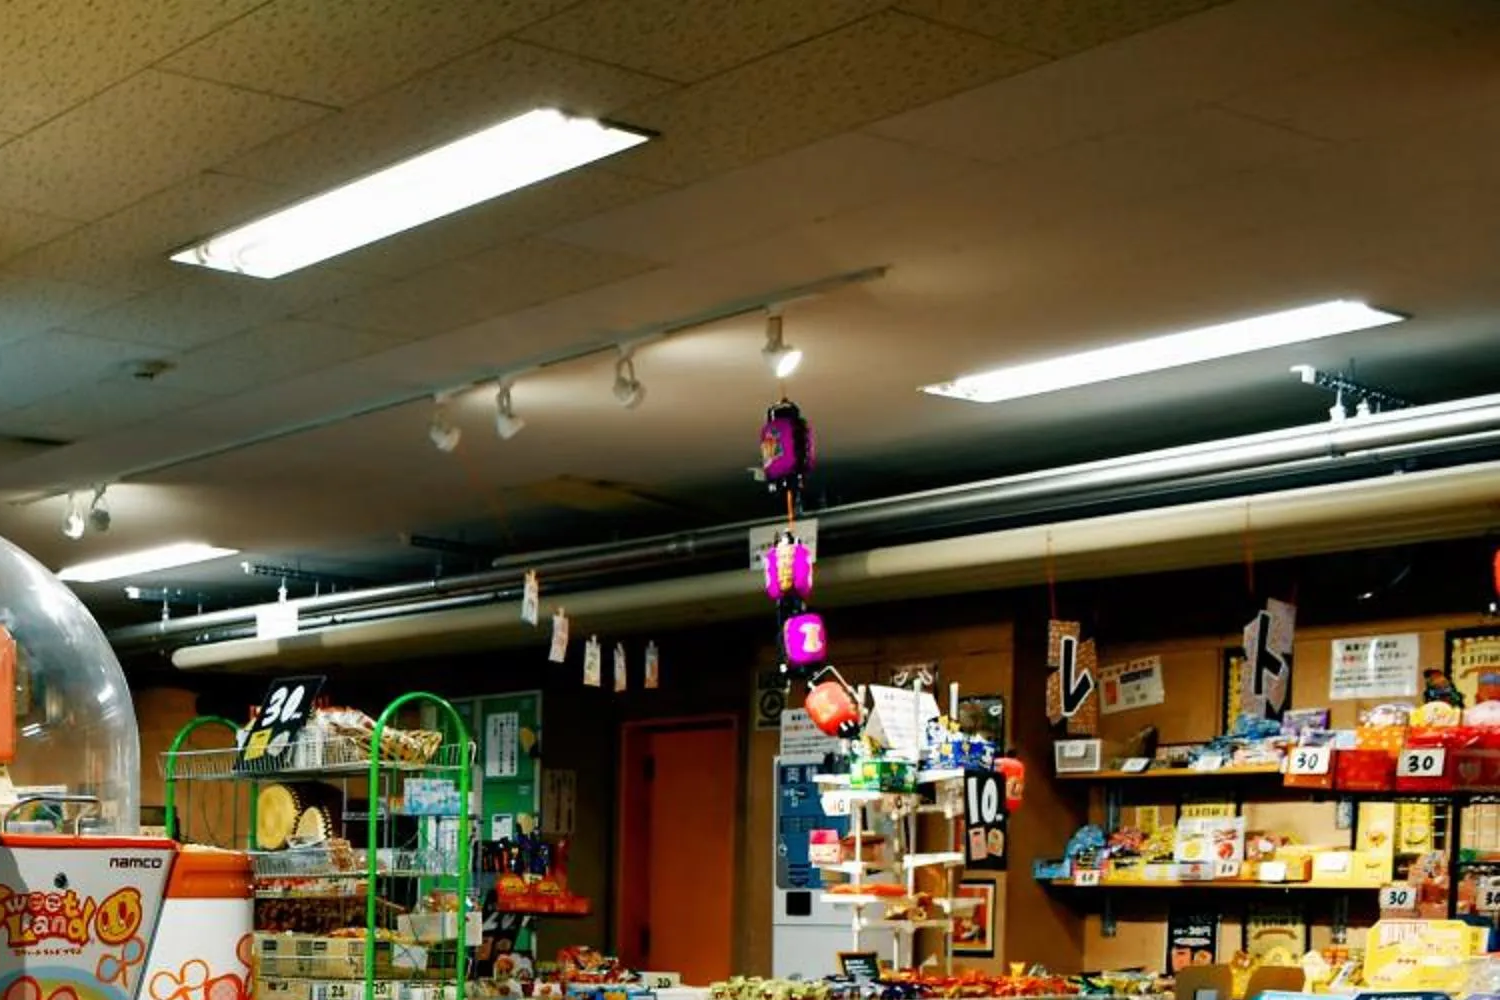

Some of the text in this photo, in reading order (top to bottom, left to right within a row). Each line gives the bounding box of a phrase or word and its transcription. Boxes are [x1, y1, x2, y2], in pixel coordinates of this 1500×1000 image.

[1297, 754, 1319, 769] 30
[1408, 755, 1434, 772] 30
[109, 856, 163, 869] namco
[1389, 890, 1408, 905] 30
[8, 896, 97, 948] Land
